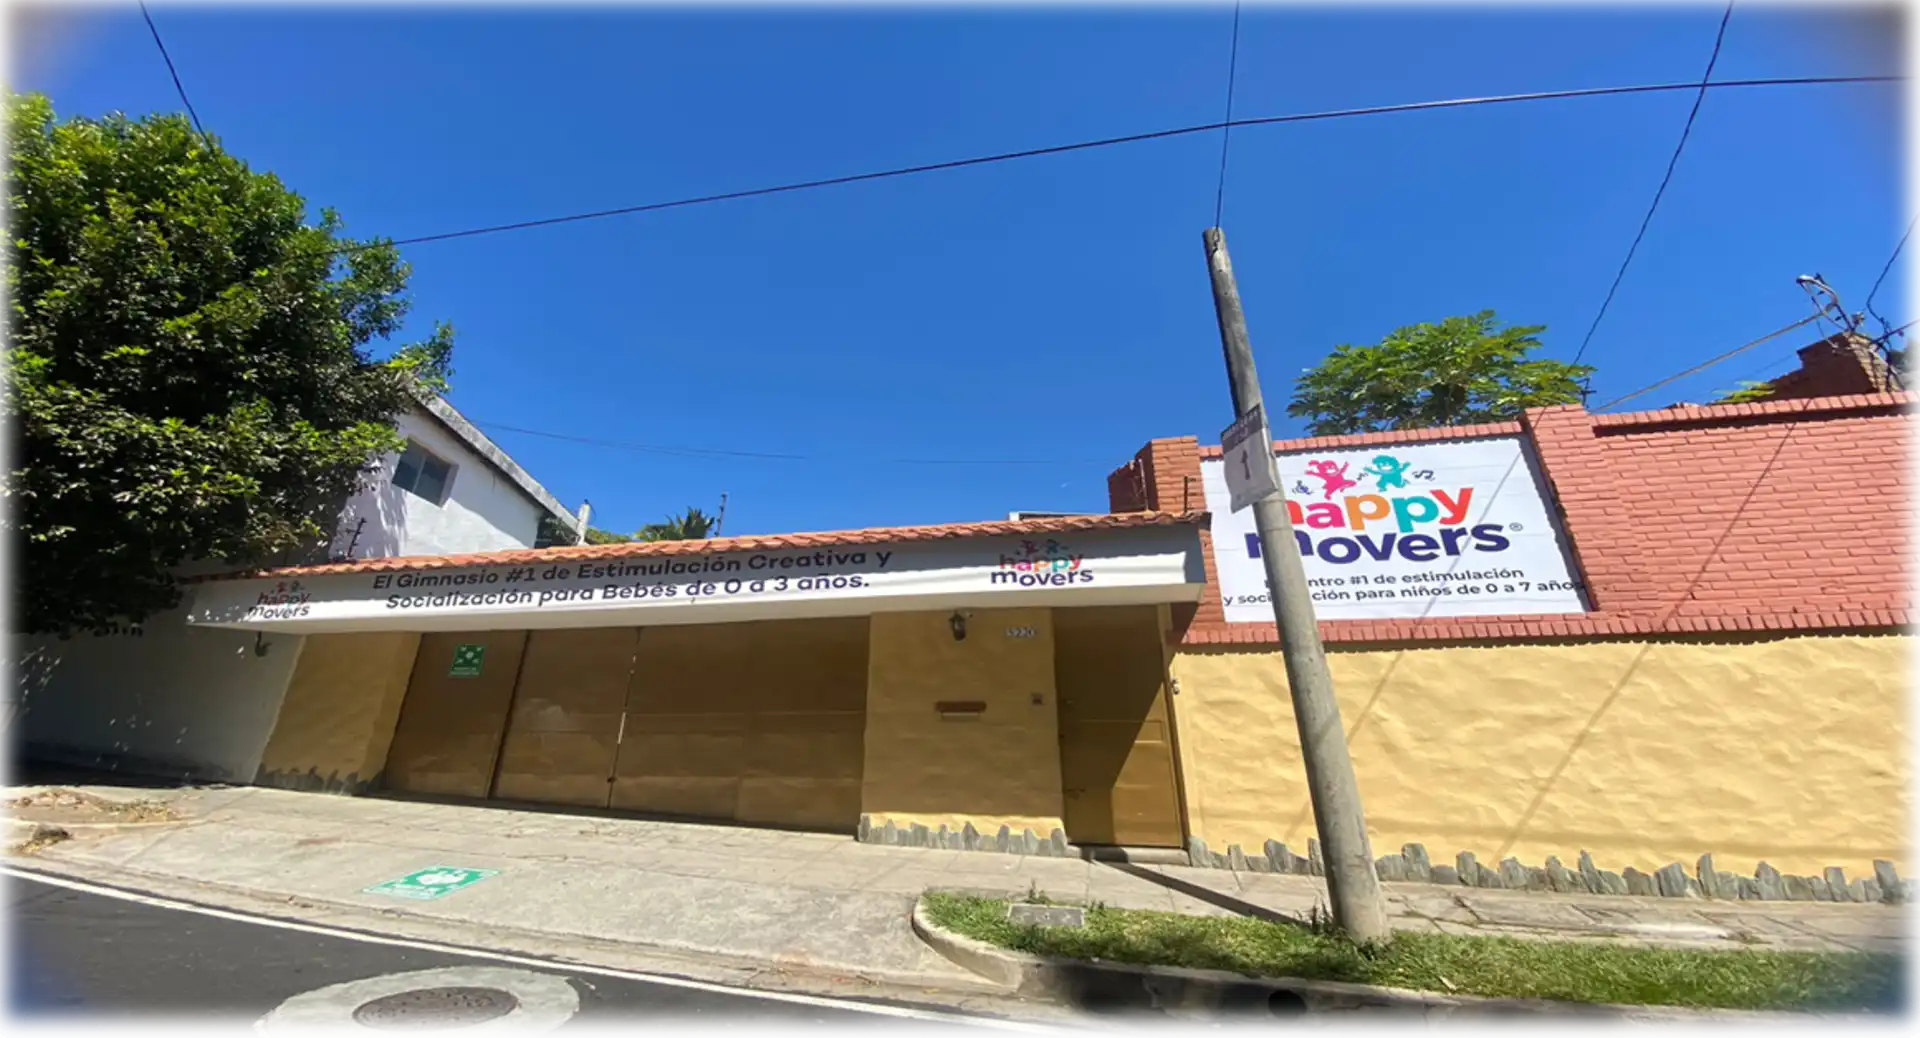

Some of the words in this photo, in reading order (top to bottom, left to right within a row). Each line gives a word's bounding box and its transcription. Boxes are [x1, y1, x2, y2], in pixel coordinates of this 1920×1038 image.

[373, 574, 394, 589] El
[397, 569, 499, 589] Gimnasio
[505, 567, 536, 583] #1
[542, 565, 570, 580] de
[577, 557, 741, 579] Estimulación
[748, 550, 867, 570] Creativa
[876, 551, 893, 568] y
[1000, 553, 1083, 572] happy
[990, 569, 1094, 586] movers
[1350, 574, 1369, 586] #1
[1374, 573, 1397, 585] de
[1402, 567, 1525, 584] estimulación
[257, 591, 312, 606] happy
[386, 589, 533, 610] Socialización
[538, 588, 594, 607] para
[602, 581, 677, 600] Bebés
[685, 580, 717, 596] de
[750, 580, 765, 593] a
[775, 575, 789, 592] 3
[797, 572, 870, 591] años.
[1223, 596, 1234, 607] y
[1237, 588, 1350, 605] socición
[1356, 589, 1396, 601] para
[1400, 583, 1452, 598] niños
[1457, 581, 1481, 595] de
[1504, 584, 1515, 593] a
[1519, 581, 1531, 592] 7
[248, 606, 310, 619] movers
